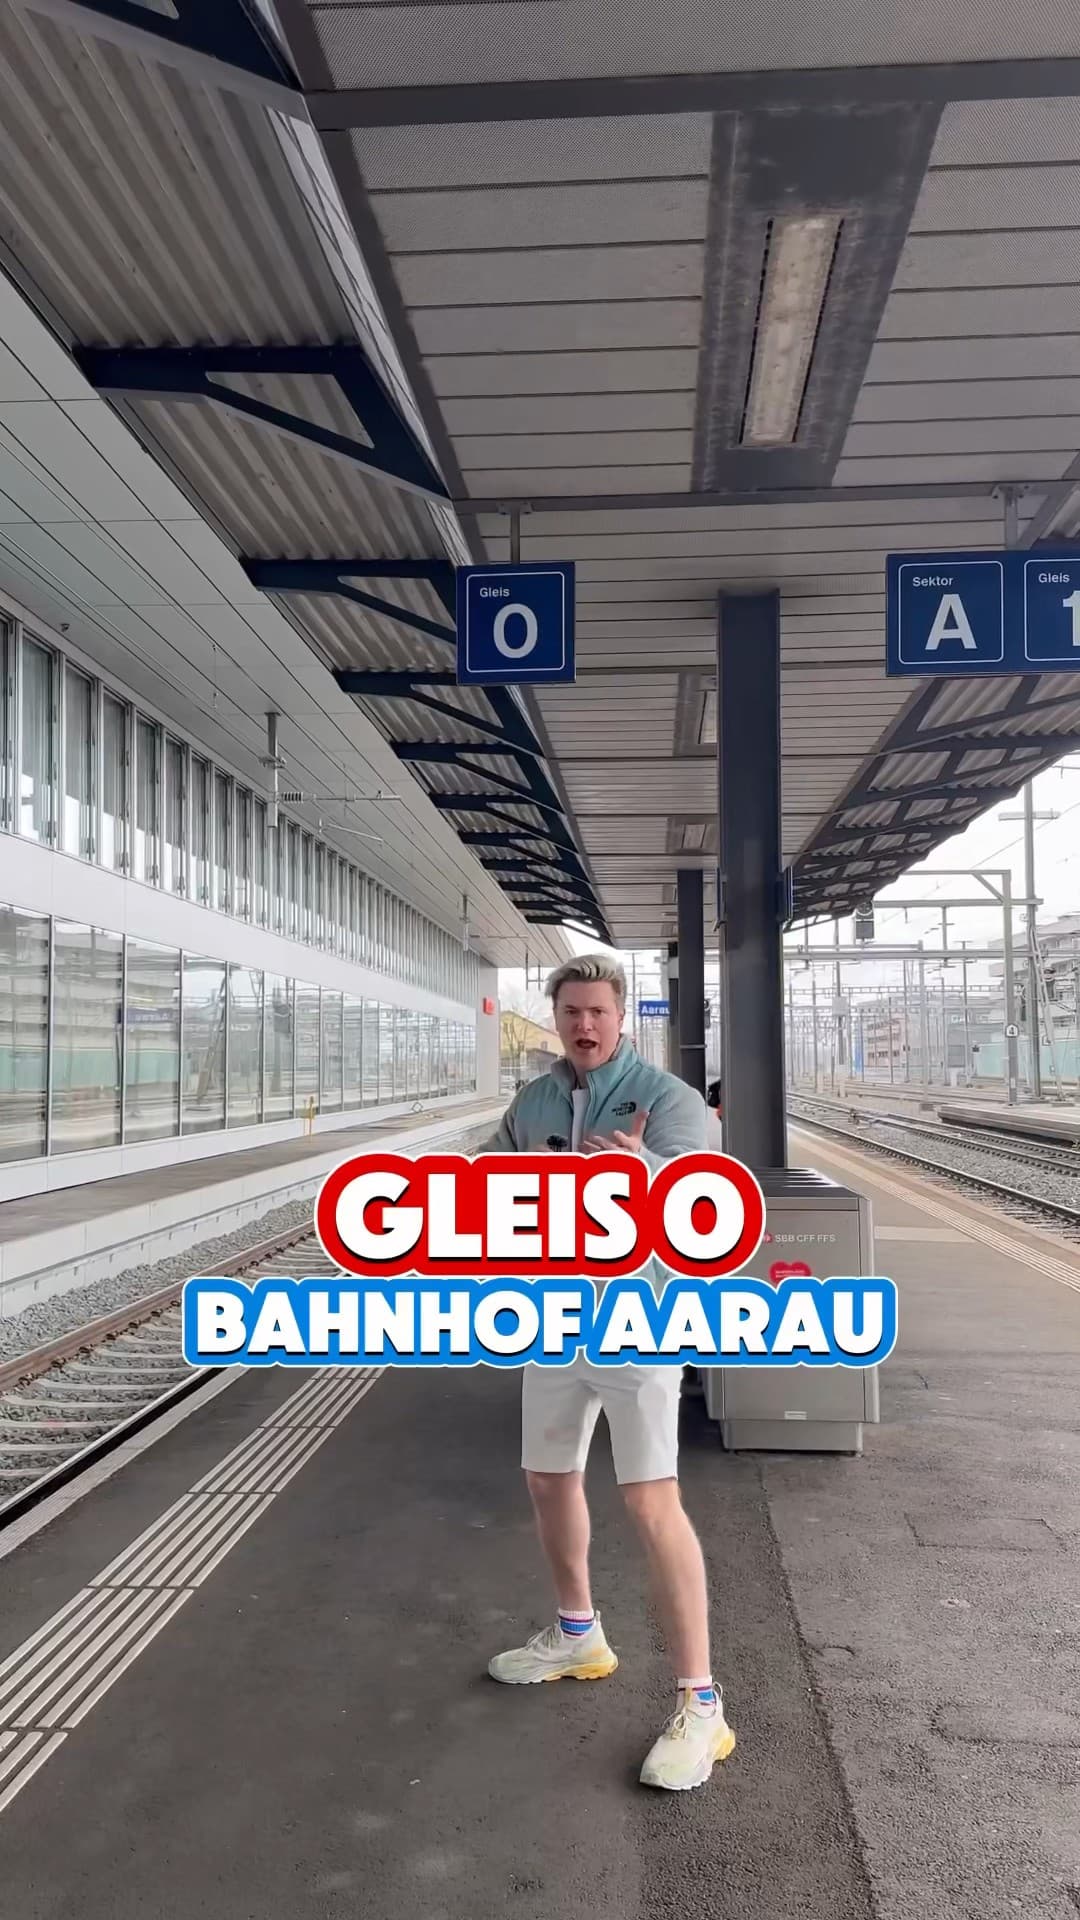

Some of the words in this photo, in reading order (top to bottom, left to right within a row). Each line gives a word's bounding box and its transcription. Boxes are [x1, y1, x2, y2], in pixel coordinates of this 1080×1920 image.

[912, 575, 953, 587] Sektor
[1038, 572, 1070, 583] Gleis
[479, 587, 510, 598] Gleis
[925, 593, 977, 650] A
[493, 603, 538, 659] 0
[775, 1233, 795, 1243] SBB
[796, 1233, 816, 1243] CFF
[817, 1233, 836, 1243] FFS
